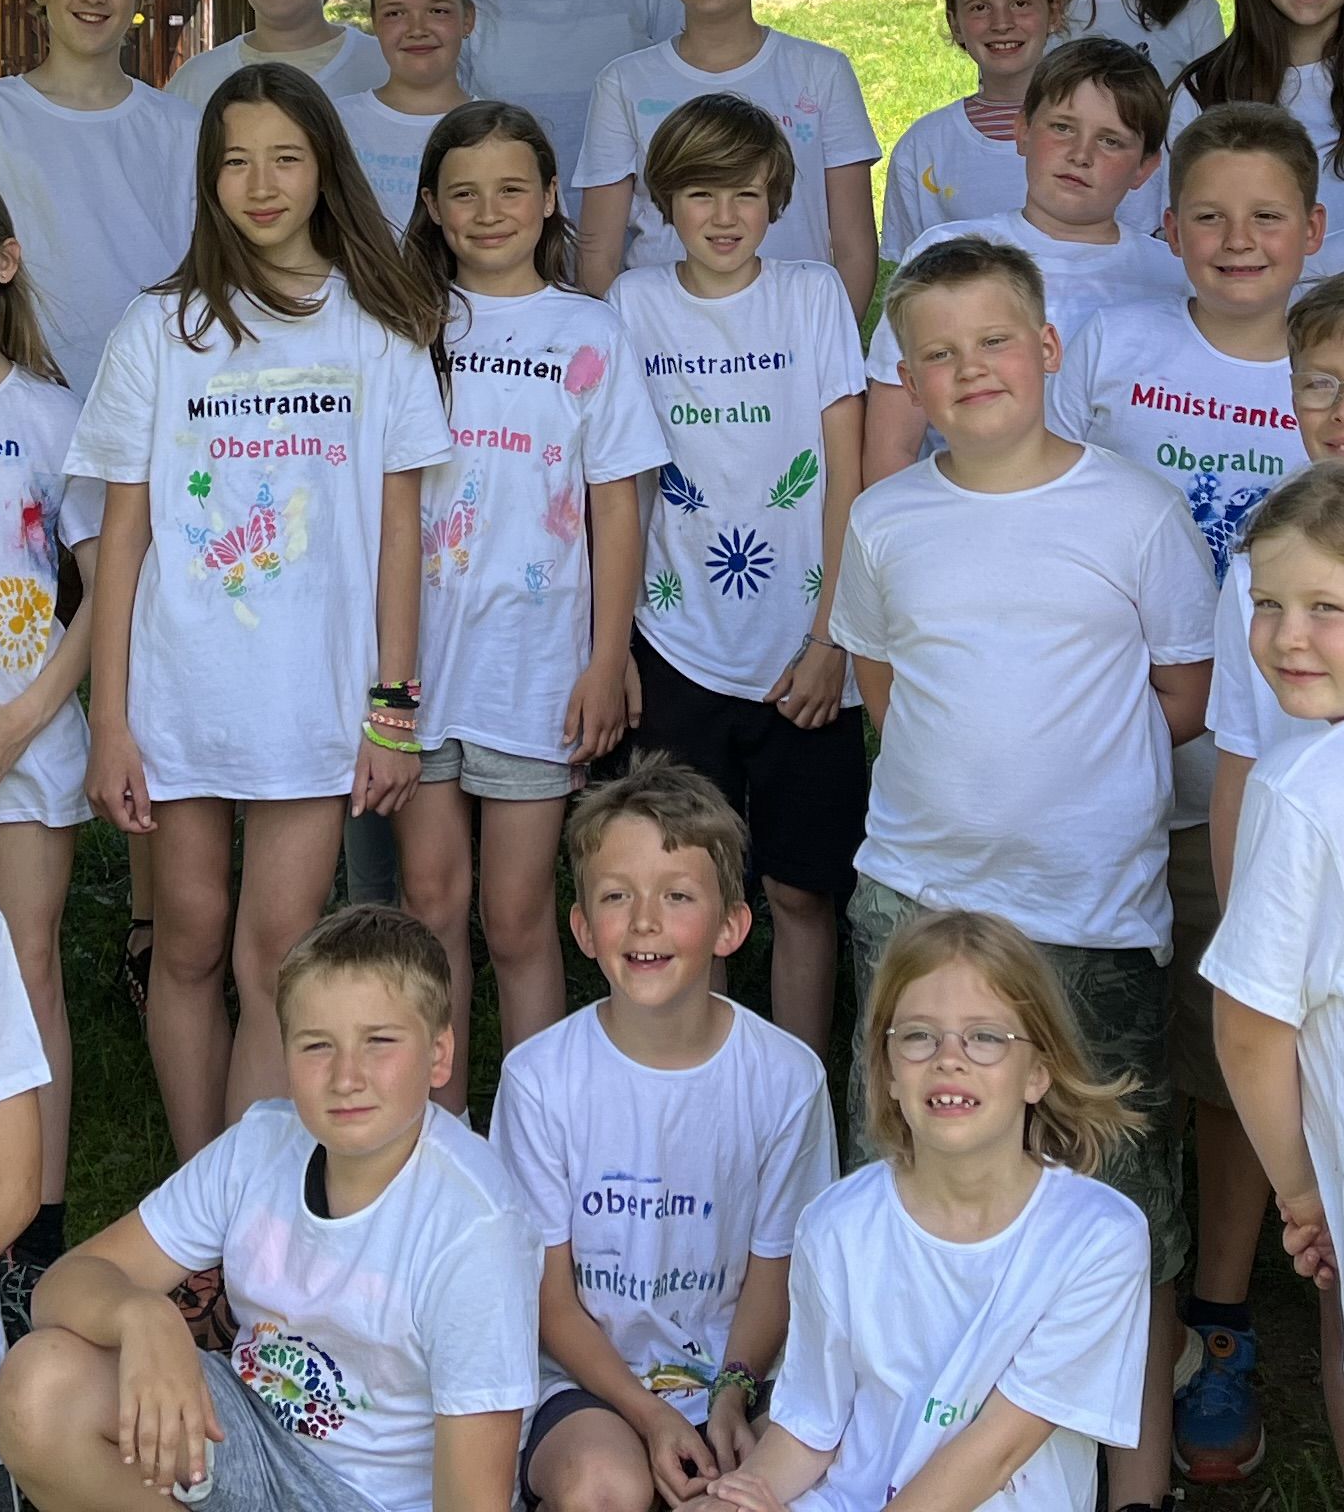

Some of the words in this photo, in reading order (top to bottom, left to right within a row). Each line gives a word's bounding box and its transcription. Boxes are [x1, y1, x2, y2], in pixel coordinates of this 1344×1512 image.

[645, 351, 786, 377] Ministranten
[188, 391, 352, 421] Ministranten
[670, 401, 772, 425] Oberalm
[1131, 382, 1299, 431] Ministrante
[209, 433, 322, 460] Oberalm
[1157, 442, 1285, 476] Oberalm
[582, 1187, 697, 1221] Oberalm
